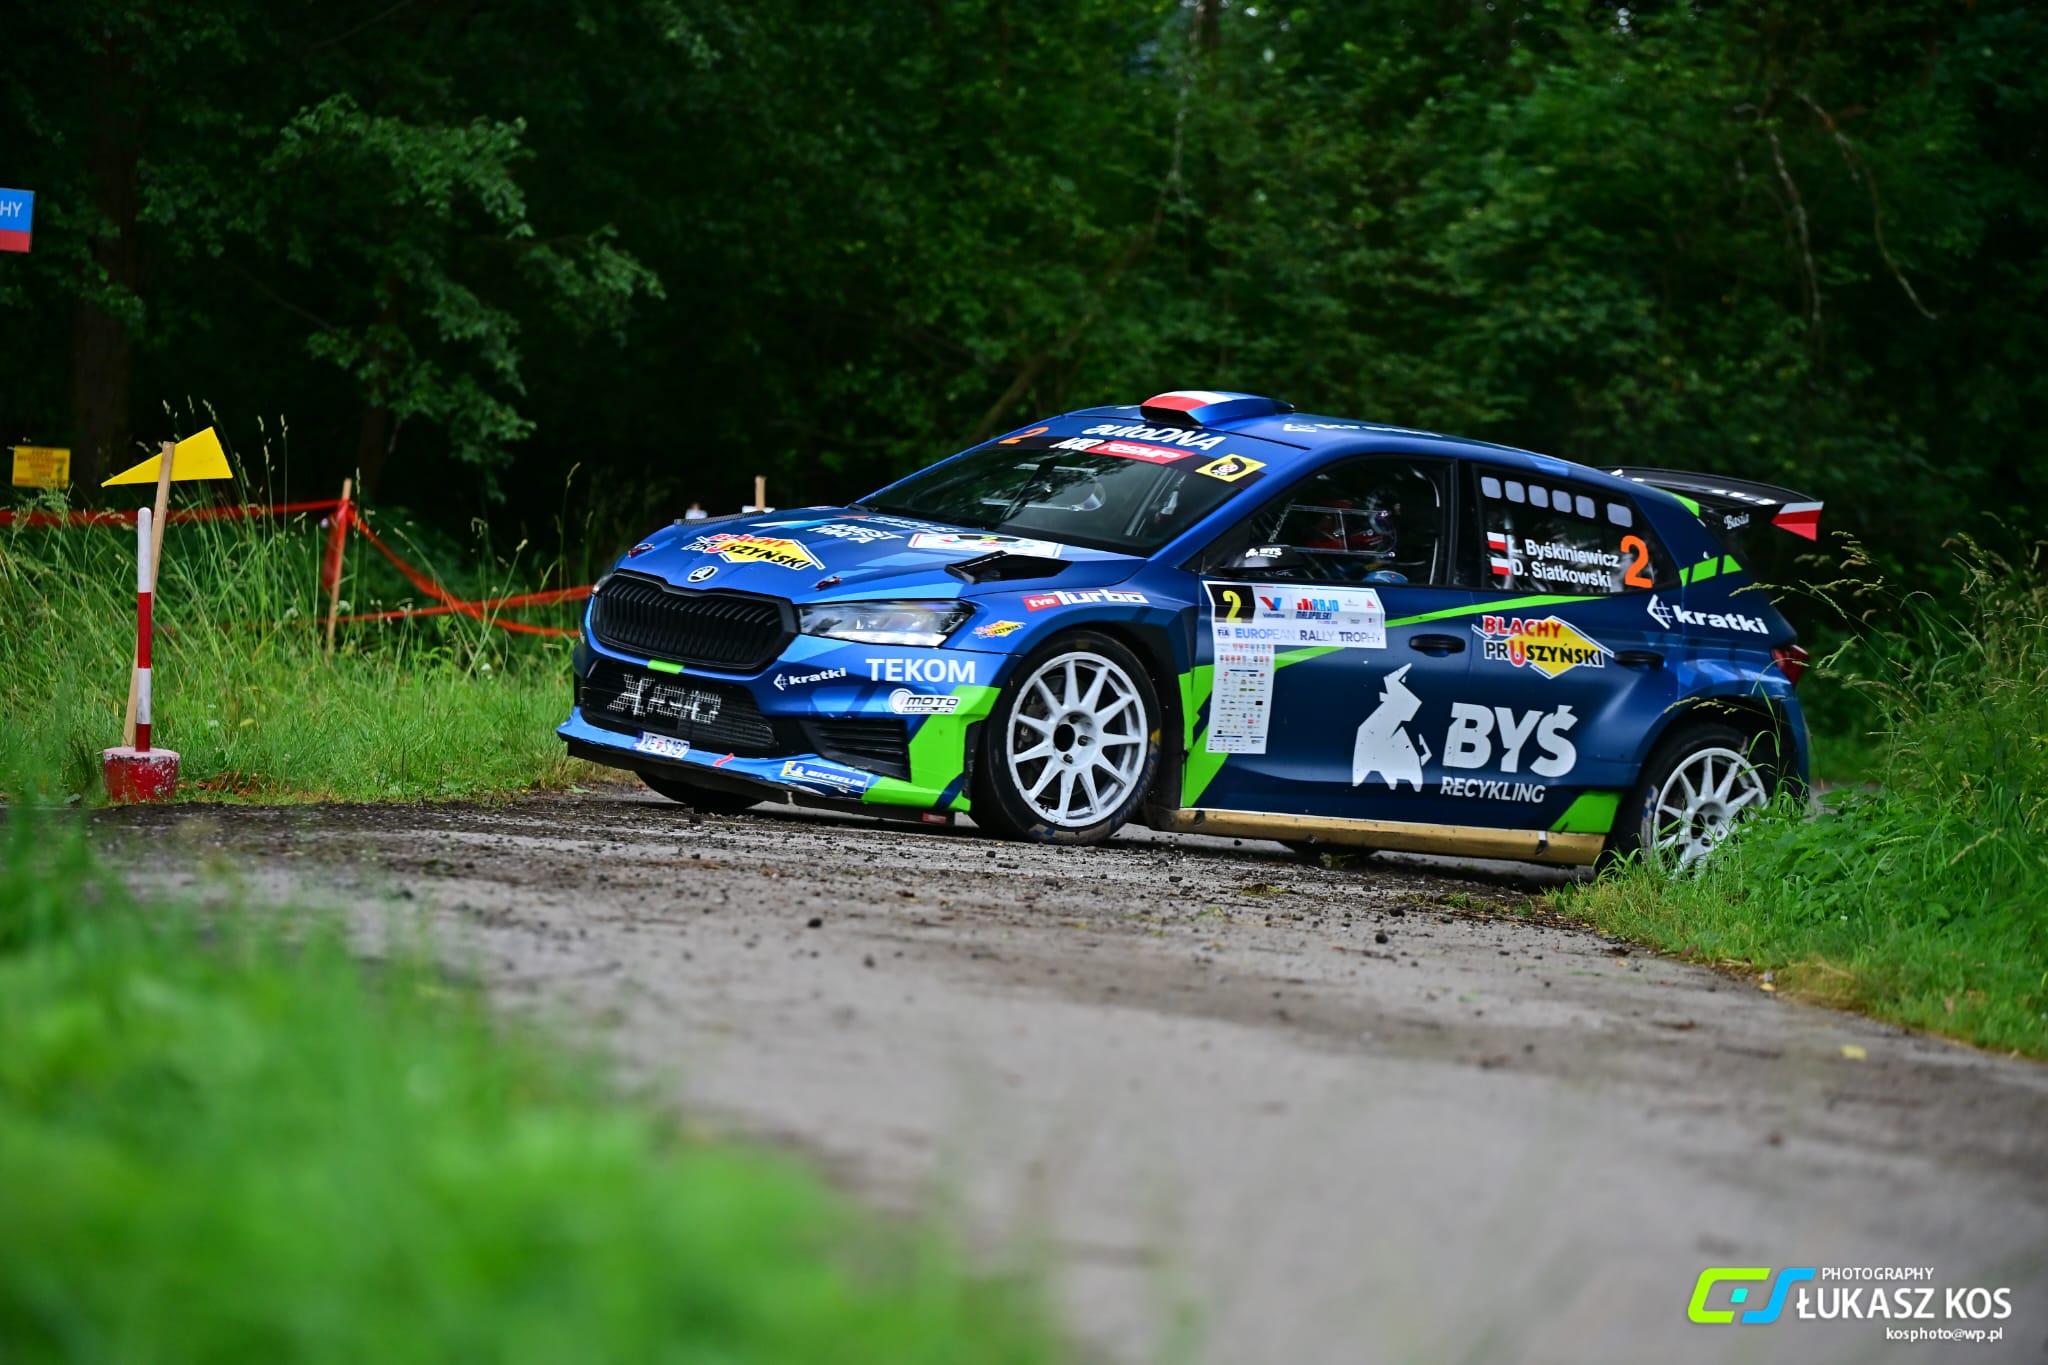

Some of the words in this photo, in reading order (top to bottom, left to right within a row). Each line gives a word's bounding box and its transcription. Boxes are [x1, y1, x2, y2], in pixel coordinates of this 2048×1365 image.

[998, 427, 1049, 444] 2
[1082, 424, 1226, 451] autoDNA
[706, 534, 794, 548] BLACHY
[1525, 539, 1620, 568] Byśkiniewicz
[1511, 559, 1528, 577] D.
[1531, 562, 1612, 587] Siatkowski
[1620, 535, 1653, 588] 2
[1222, 590, 1242, 624] 2
[1672, 605, 1769, 635] kratki
[1235, 628, 1296, 641] EUROPEAN
[1300, 630, 1334, 641] RALLY
[1339, 632, 1381, 643] TROPHY
[1484, 617, 1562, 639] BLACHY
[1485, 640, 1604, 666] PRUSZYŃSKI
[789, 668, 847, 685] kratki
[865, 658, 976, 683] TEKOM
[906, 697, 959, 706] MOTO
[1442, 702, 1579, 778] BYŚ
[805, 769, 866, 787] MICHELIN
[1440, 776, 1546, 803] RECYKLING
